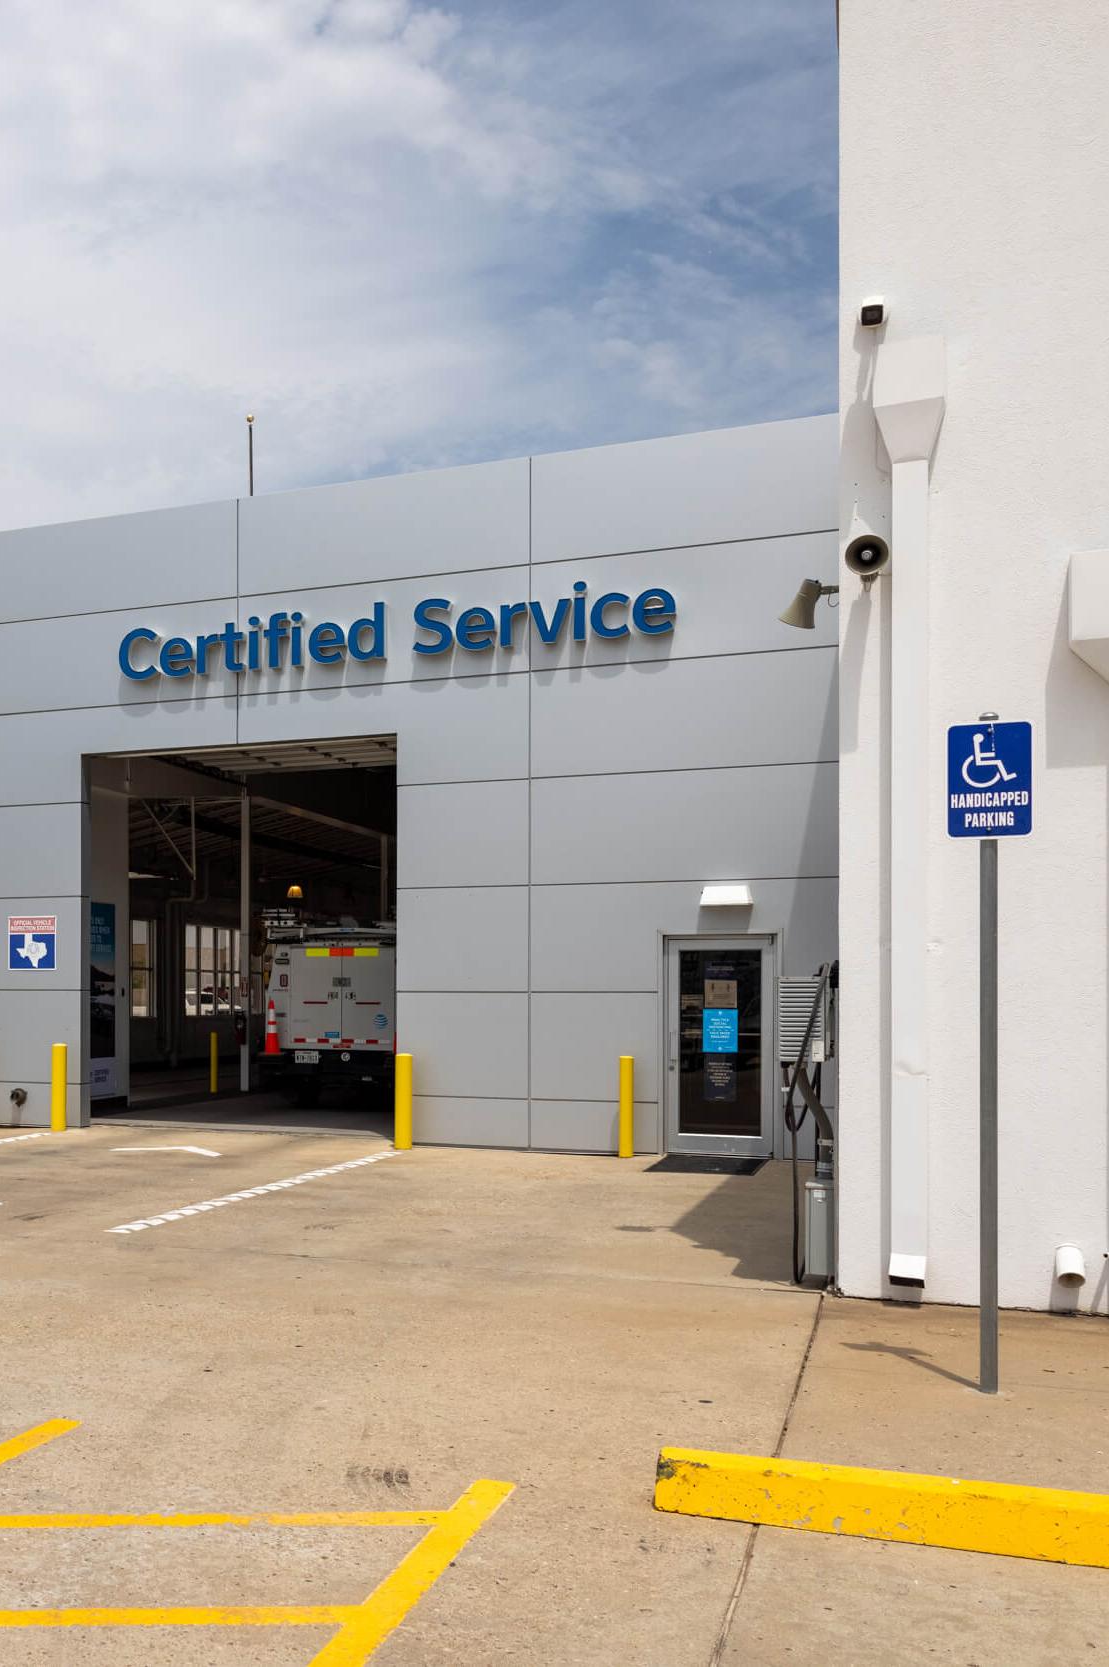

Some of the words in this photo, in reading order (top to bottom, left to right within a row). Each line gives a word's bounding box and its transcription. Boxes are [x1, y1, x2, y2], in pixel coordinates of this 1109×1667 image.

[118, 601, 387, 680] Certified
[412, 581, 677, 655] Service
[950, 791, 1029, 809] HANDICAPPED
[964, 811, 1014, 828] PARKING
